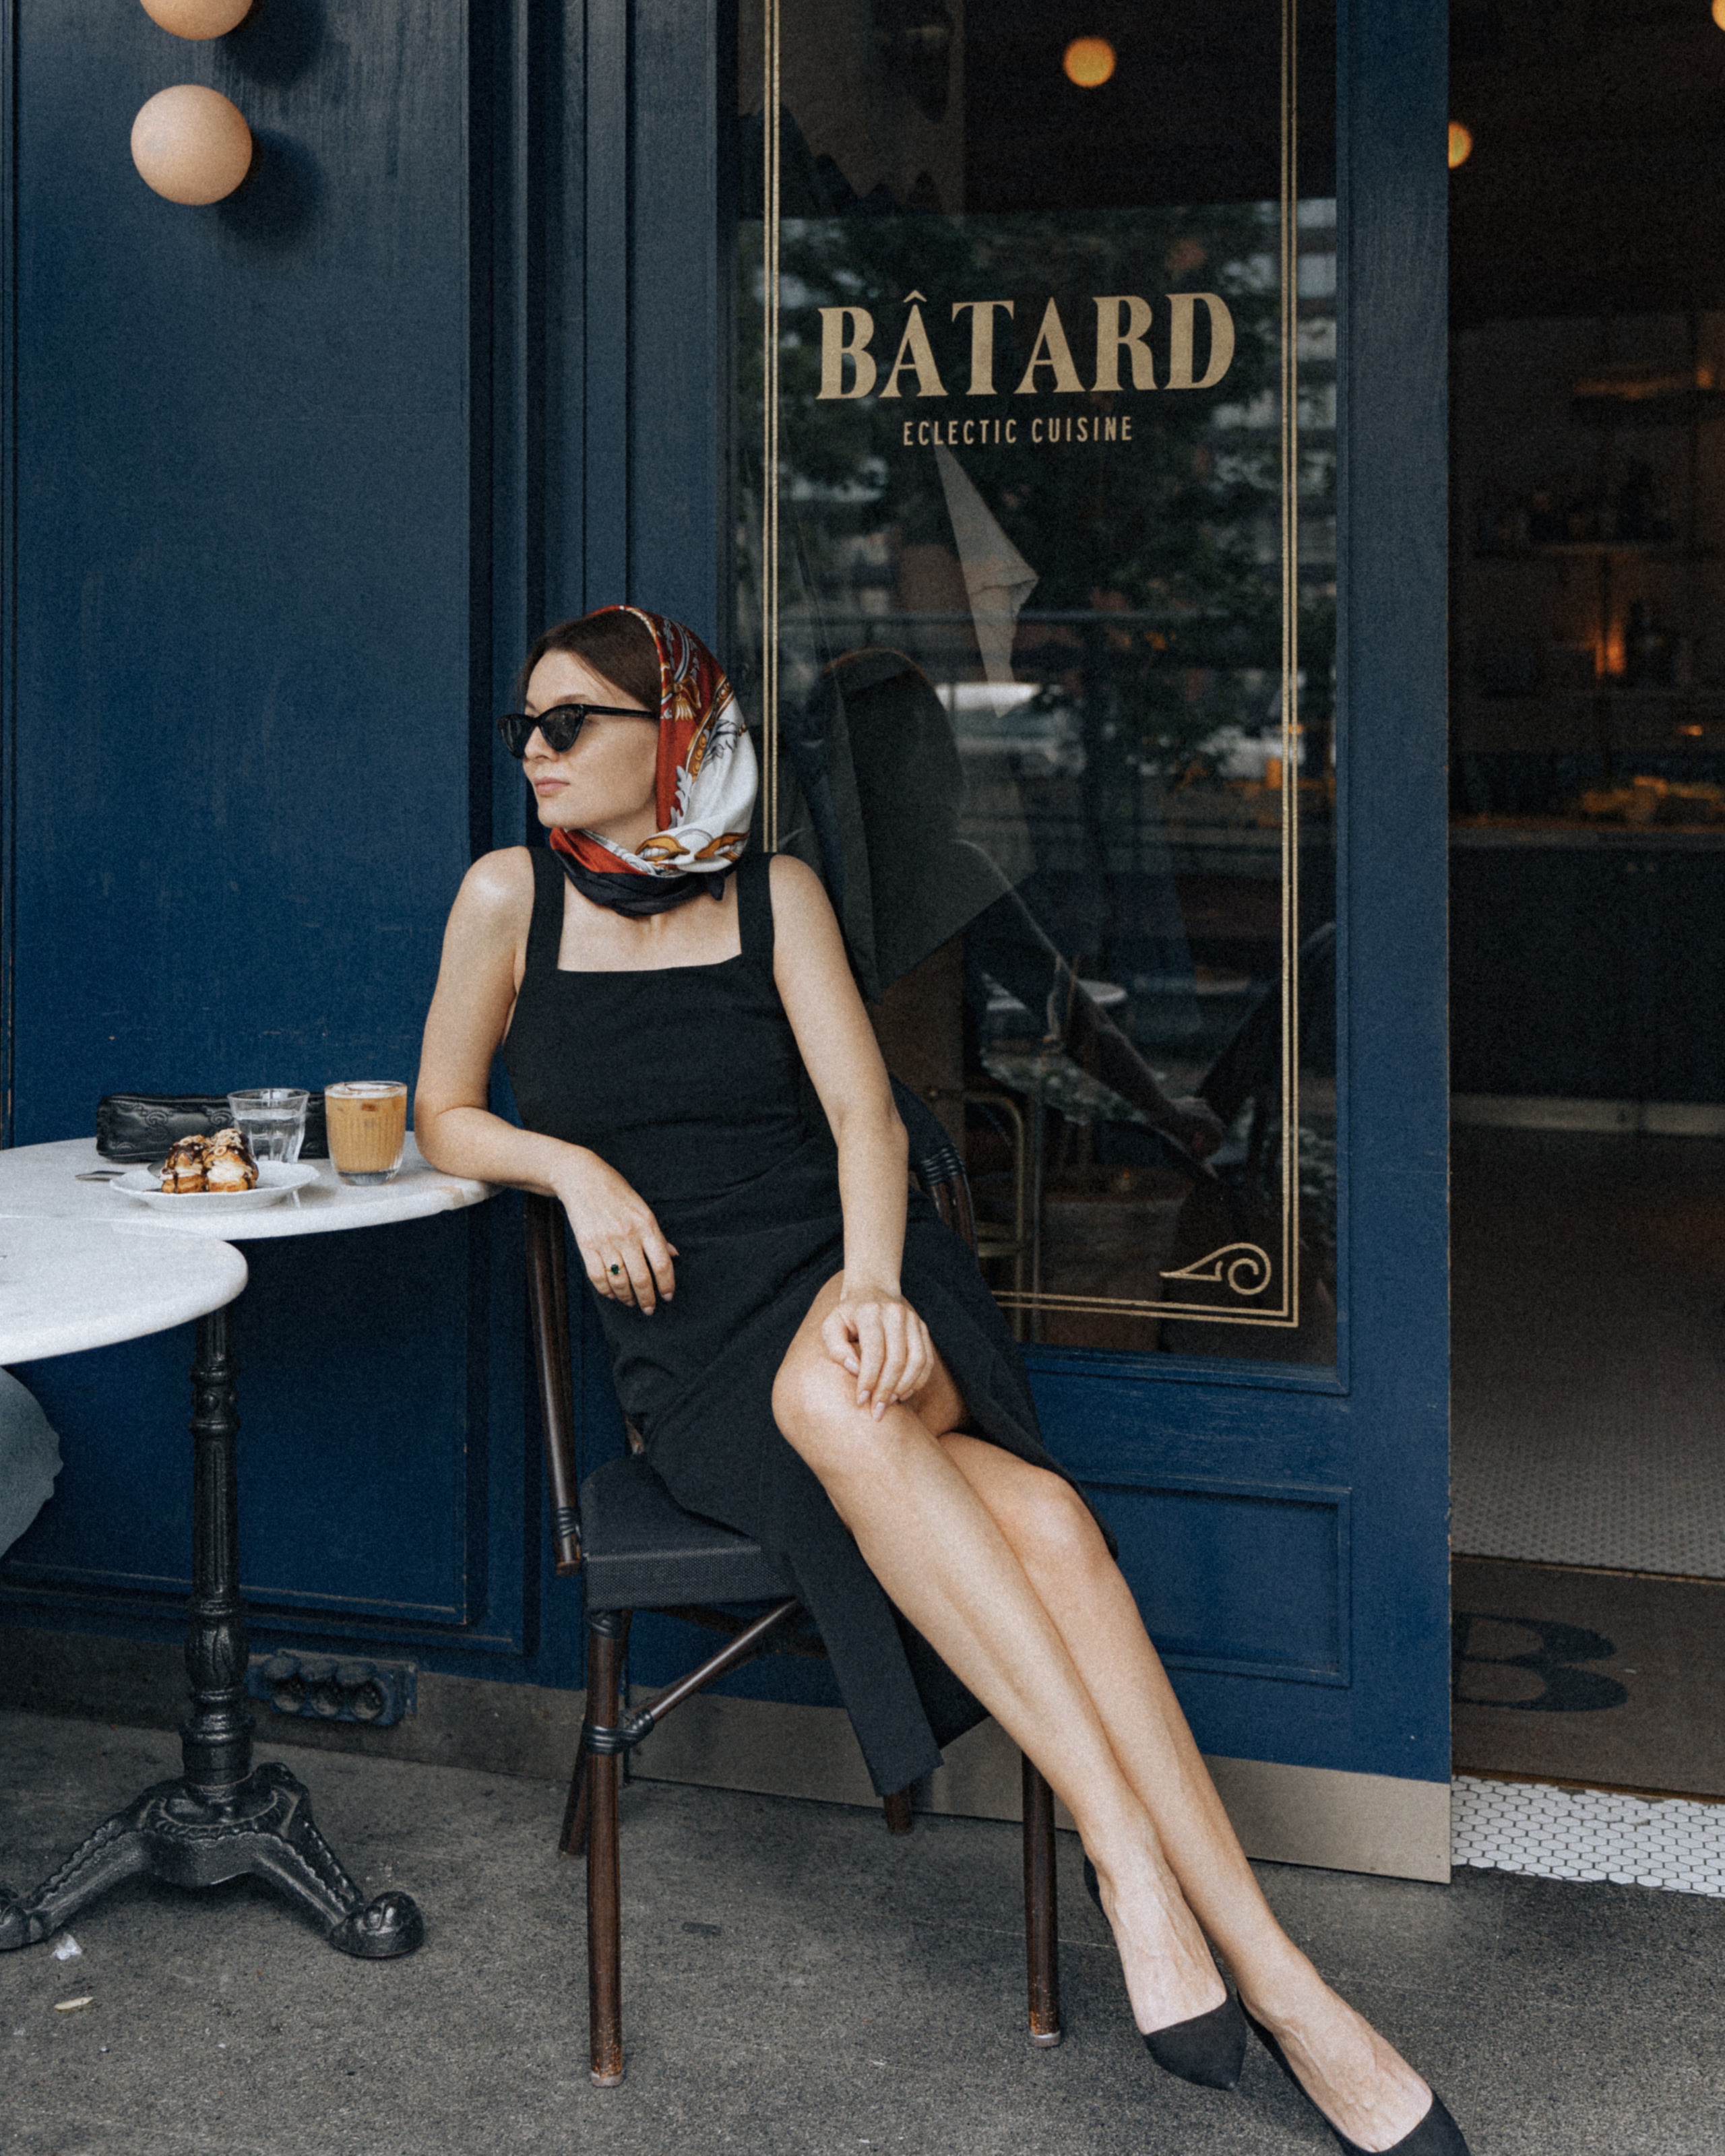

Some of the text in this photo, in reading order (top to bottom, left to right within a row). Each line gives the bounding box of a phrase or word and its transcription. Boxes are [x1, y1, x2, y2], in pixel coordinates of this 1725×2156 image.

[816, 290, 1235, 400] BÂTARD
[903, 416, 1132, 445] ECLECTIC CUISINE
